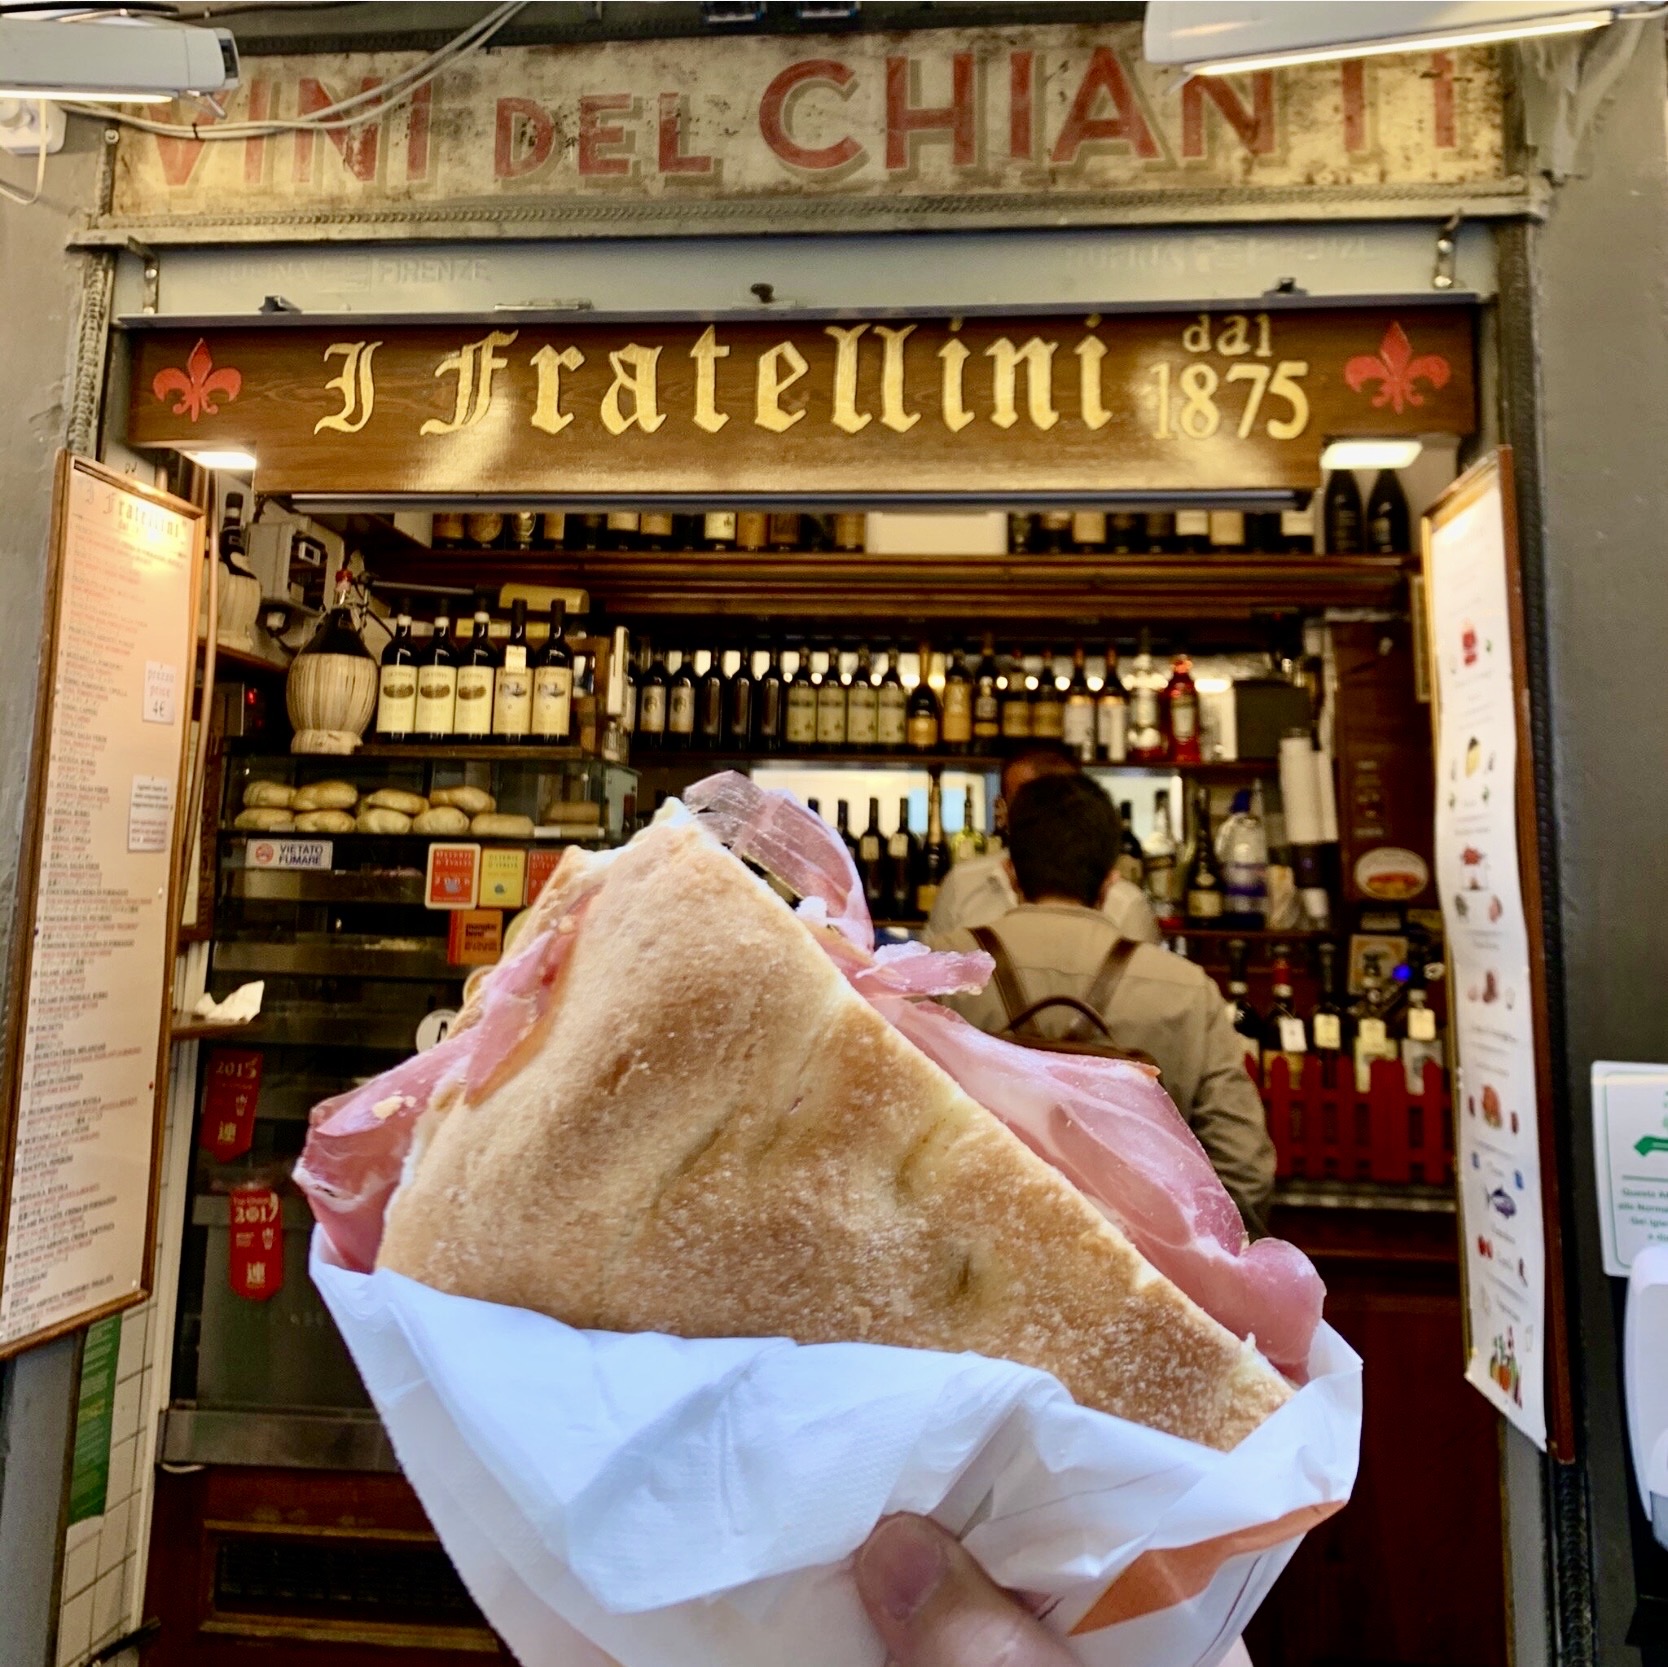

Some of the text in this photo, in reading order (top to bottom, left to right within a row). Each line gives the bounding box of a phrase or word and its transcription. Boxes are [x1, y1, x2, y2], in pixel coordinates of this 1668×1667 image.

[145, 75, 434, 187] VINI
[494, 92, 712, 178] DEL
[373, 257, 491, 282] FIRENZE
[419, 314, 1114, 435] Fratellini
[1182, 314, 1274, 357] dal
[1148, 360, 1310, 440] 1875
